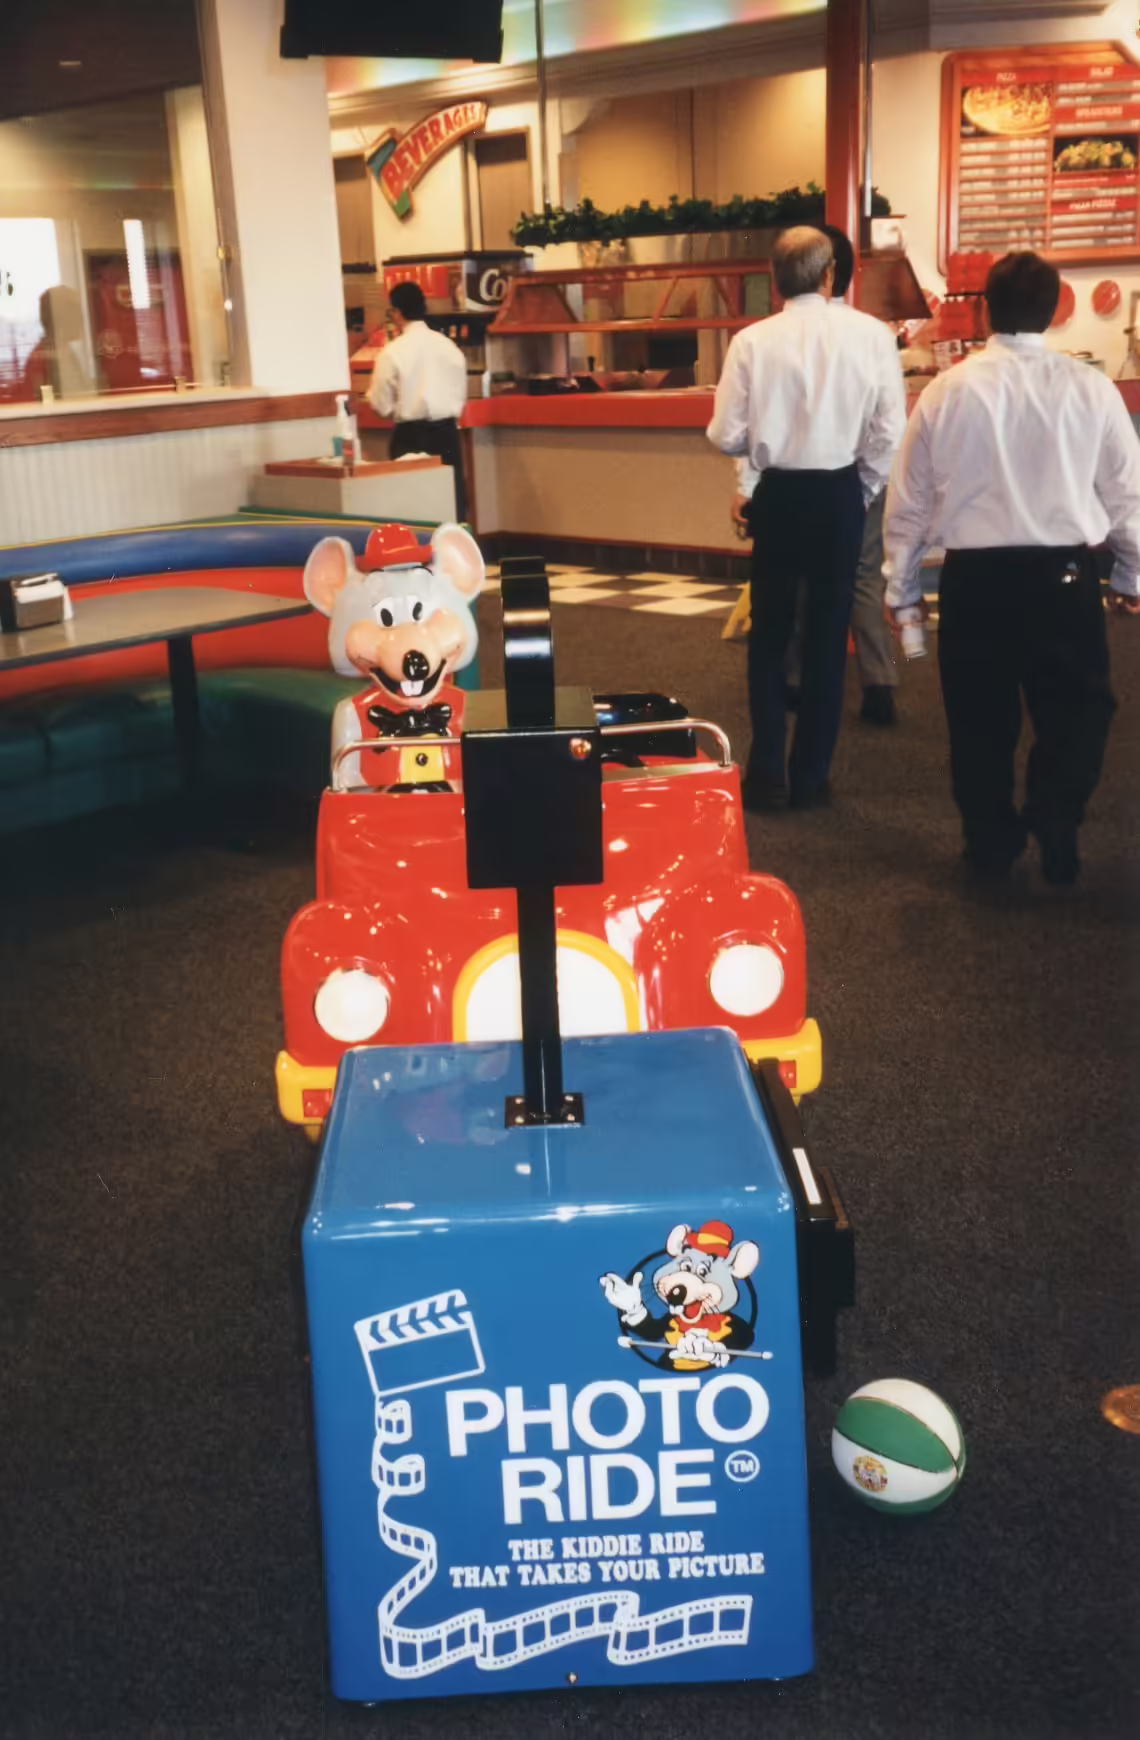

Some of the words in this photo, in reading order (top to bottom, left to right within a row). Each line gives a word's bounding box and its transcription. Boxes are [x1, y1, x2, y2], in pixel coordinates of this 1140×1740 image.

[382, 104, 476, 201] BEVERAGES
[446, 1373, 770, 1457] PHOTO
[501, 1449, 717, 1525] RIDE
[449, 1565, 510, 1588] THAT
[517, 1562, 592, 1585] TAKES
[598, 1558, 661, 1582] YOUR
[668, 1552, 765, 1578] PICTURE
[508, 1538, 554, 1561] THE
[561, 1534, 642, 1558] KIDDIE
[649, 1530, 705, 1554] RIDE
